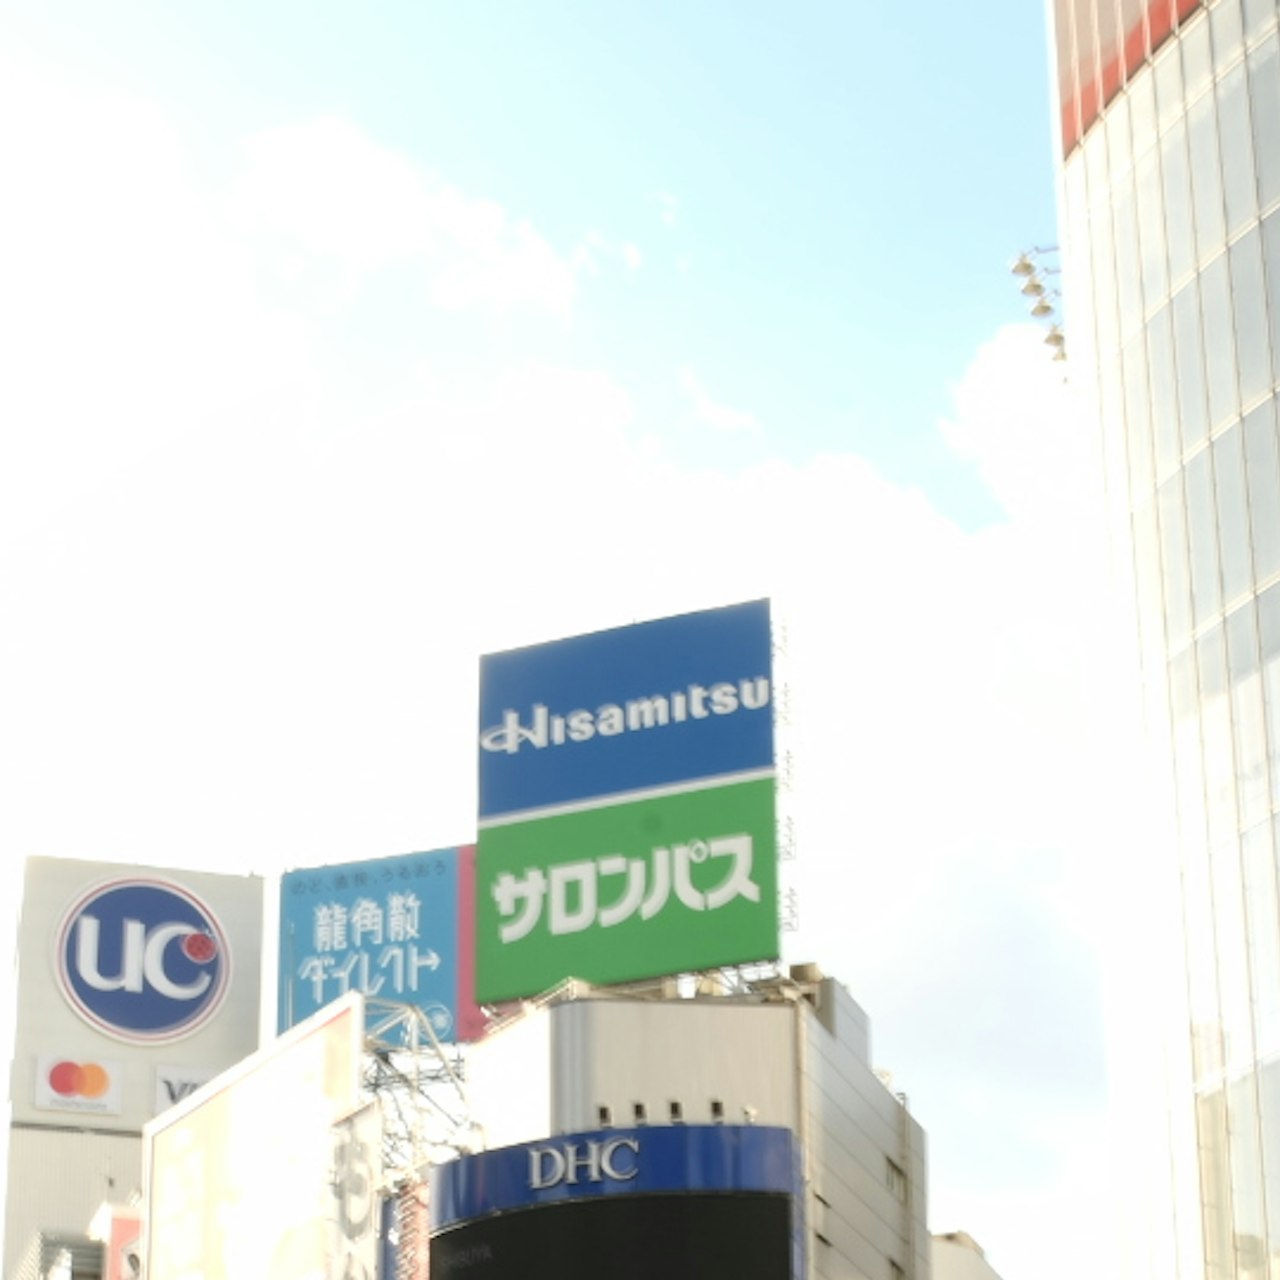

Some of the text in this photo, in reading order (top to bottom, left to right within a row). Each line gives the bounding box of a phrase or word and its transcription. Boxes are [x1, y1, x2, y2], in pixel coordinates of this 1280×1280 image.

[481, 676, 769, 754] Hisamitsu
[492, 832, 760, 944] サロンパス
[313, 889, 422, 952] 龍角散
[297, 943, 442, 1004] ダイレクト
[528, 1134, 640, 1191] DHC
